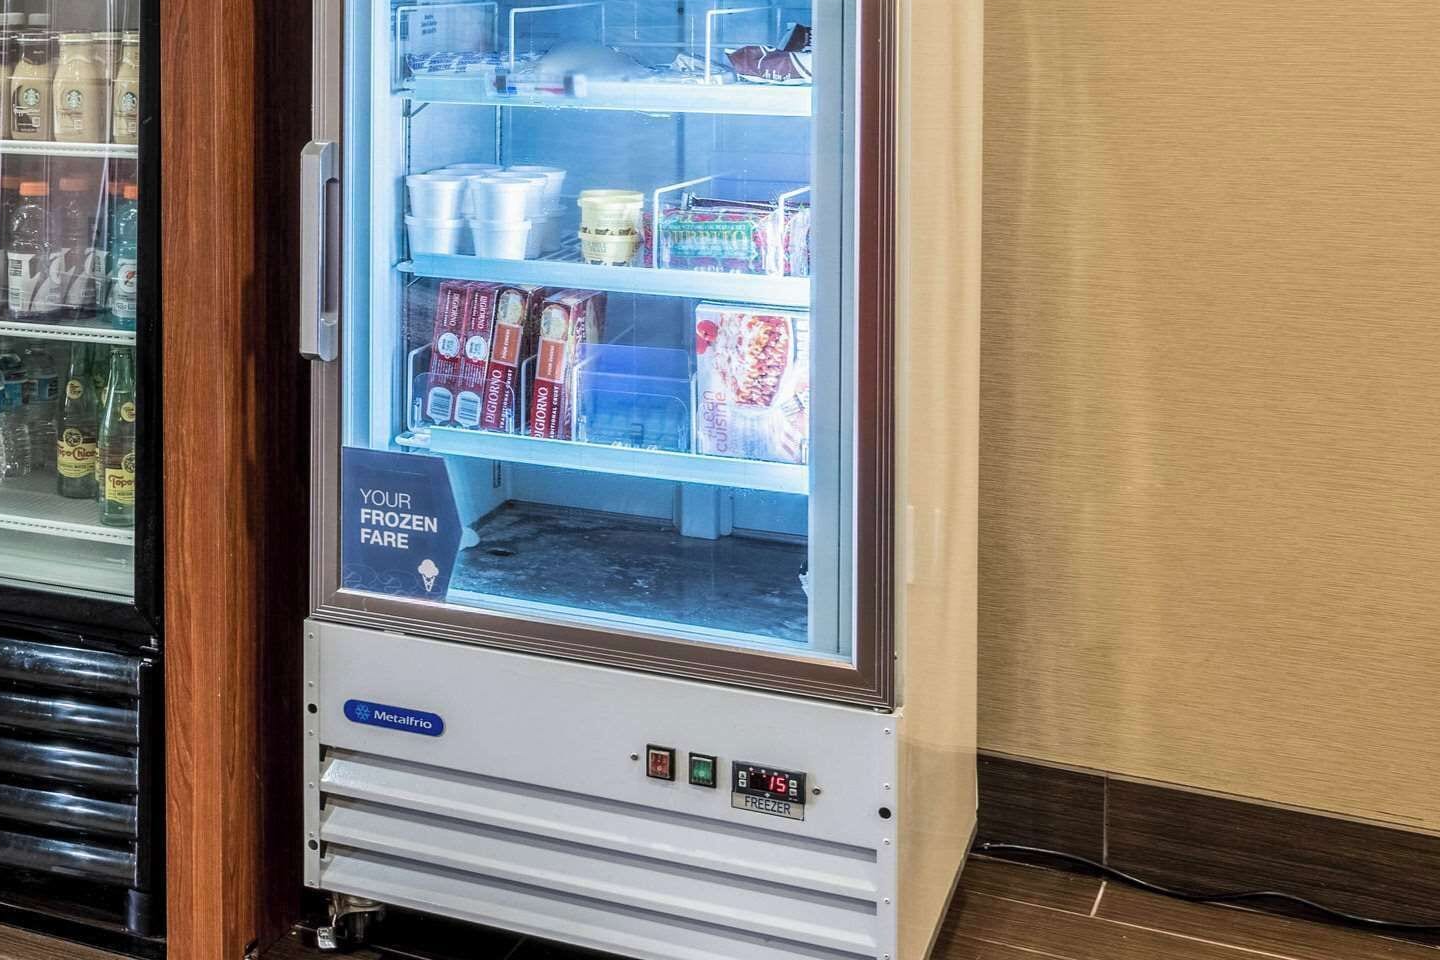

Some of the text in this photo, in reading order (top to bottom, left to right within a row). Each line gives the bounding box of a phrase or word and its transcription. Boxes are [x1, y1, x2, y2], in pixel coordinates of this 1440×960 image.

[360, 488, 411, 510] YOUR
[360, 508, 438, 533] FROZEN
[360, 528, 409, 549] FARE
[373, 709, 433, 730] Metalfrio
[768, 775, 788, 793] 15
[744, 795, 791, 815] FREEZER
